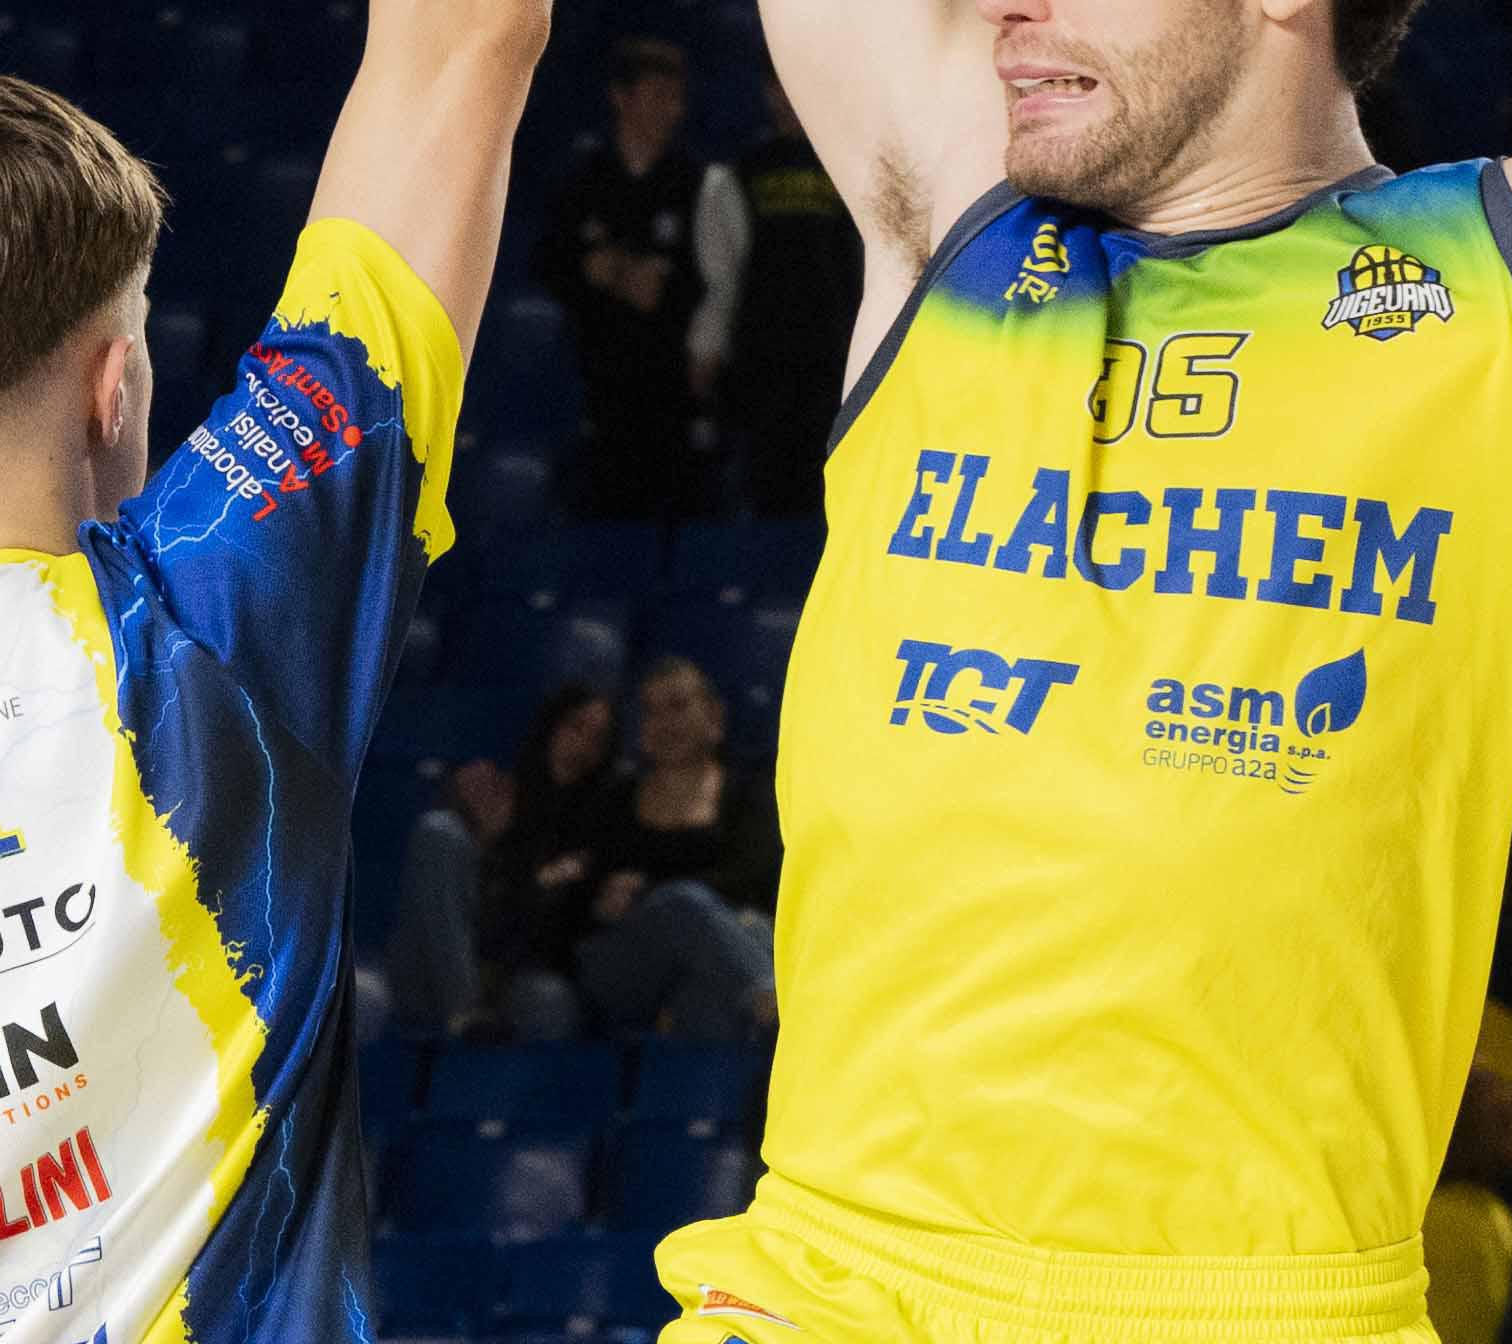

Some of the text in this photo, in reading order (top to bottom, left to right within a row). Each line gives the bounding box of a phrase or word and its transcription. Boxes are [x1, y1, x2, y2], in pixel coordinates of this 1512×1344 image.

[1329, 282, 1454, 324] VIGEVANO
[1364, 313, 1407, 328] 1955
[224, 411, 309, 493] Analisi
[887, 449, 1453, 625] ELACHEM
[1146, 678, 1284, 726] asm
[1145, 719, 1331, 760] energia s.p.a.
[1143, 748, 1277, 780] GRUPPO a2a
